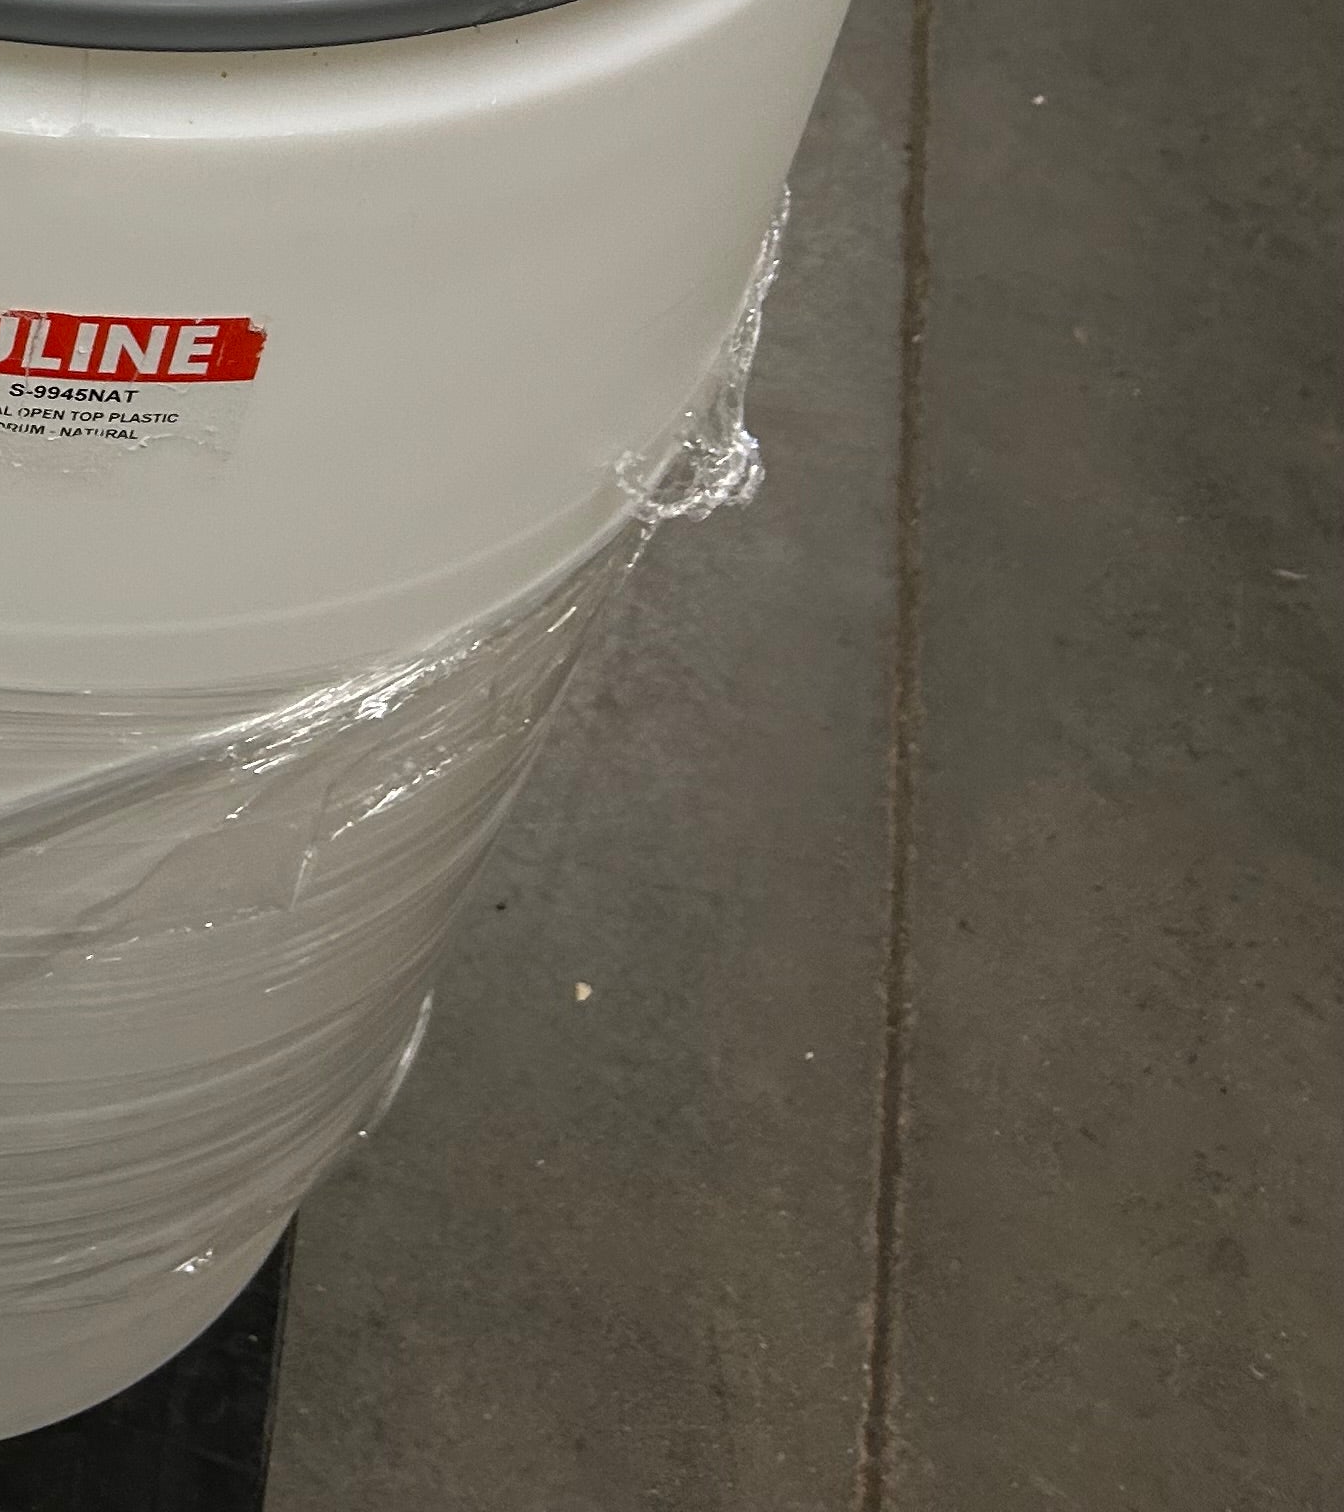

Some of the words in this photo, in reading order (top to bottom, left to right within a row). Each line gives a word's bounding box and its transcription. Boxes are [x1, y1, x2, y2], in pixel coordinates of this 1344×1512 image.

[9, 383, 140, 404] S-9945NAT
[18, 407, 66, 421] OPEN
[71, 410, 104, 422] TOP
[108, 412, 180, 424] PLASTIC
[59, 427, 139, 440] NATURAL
